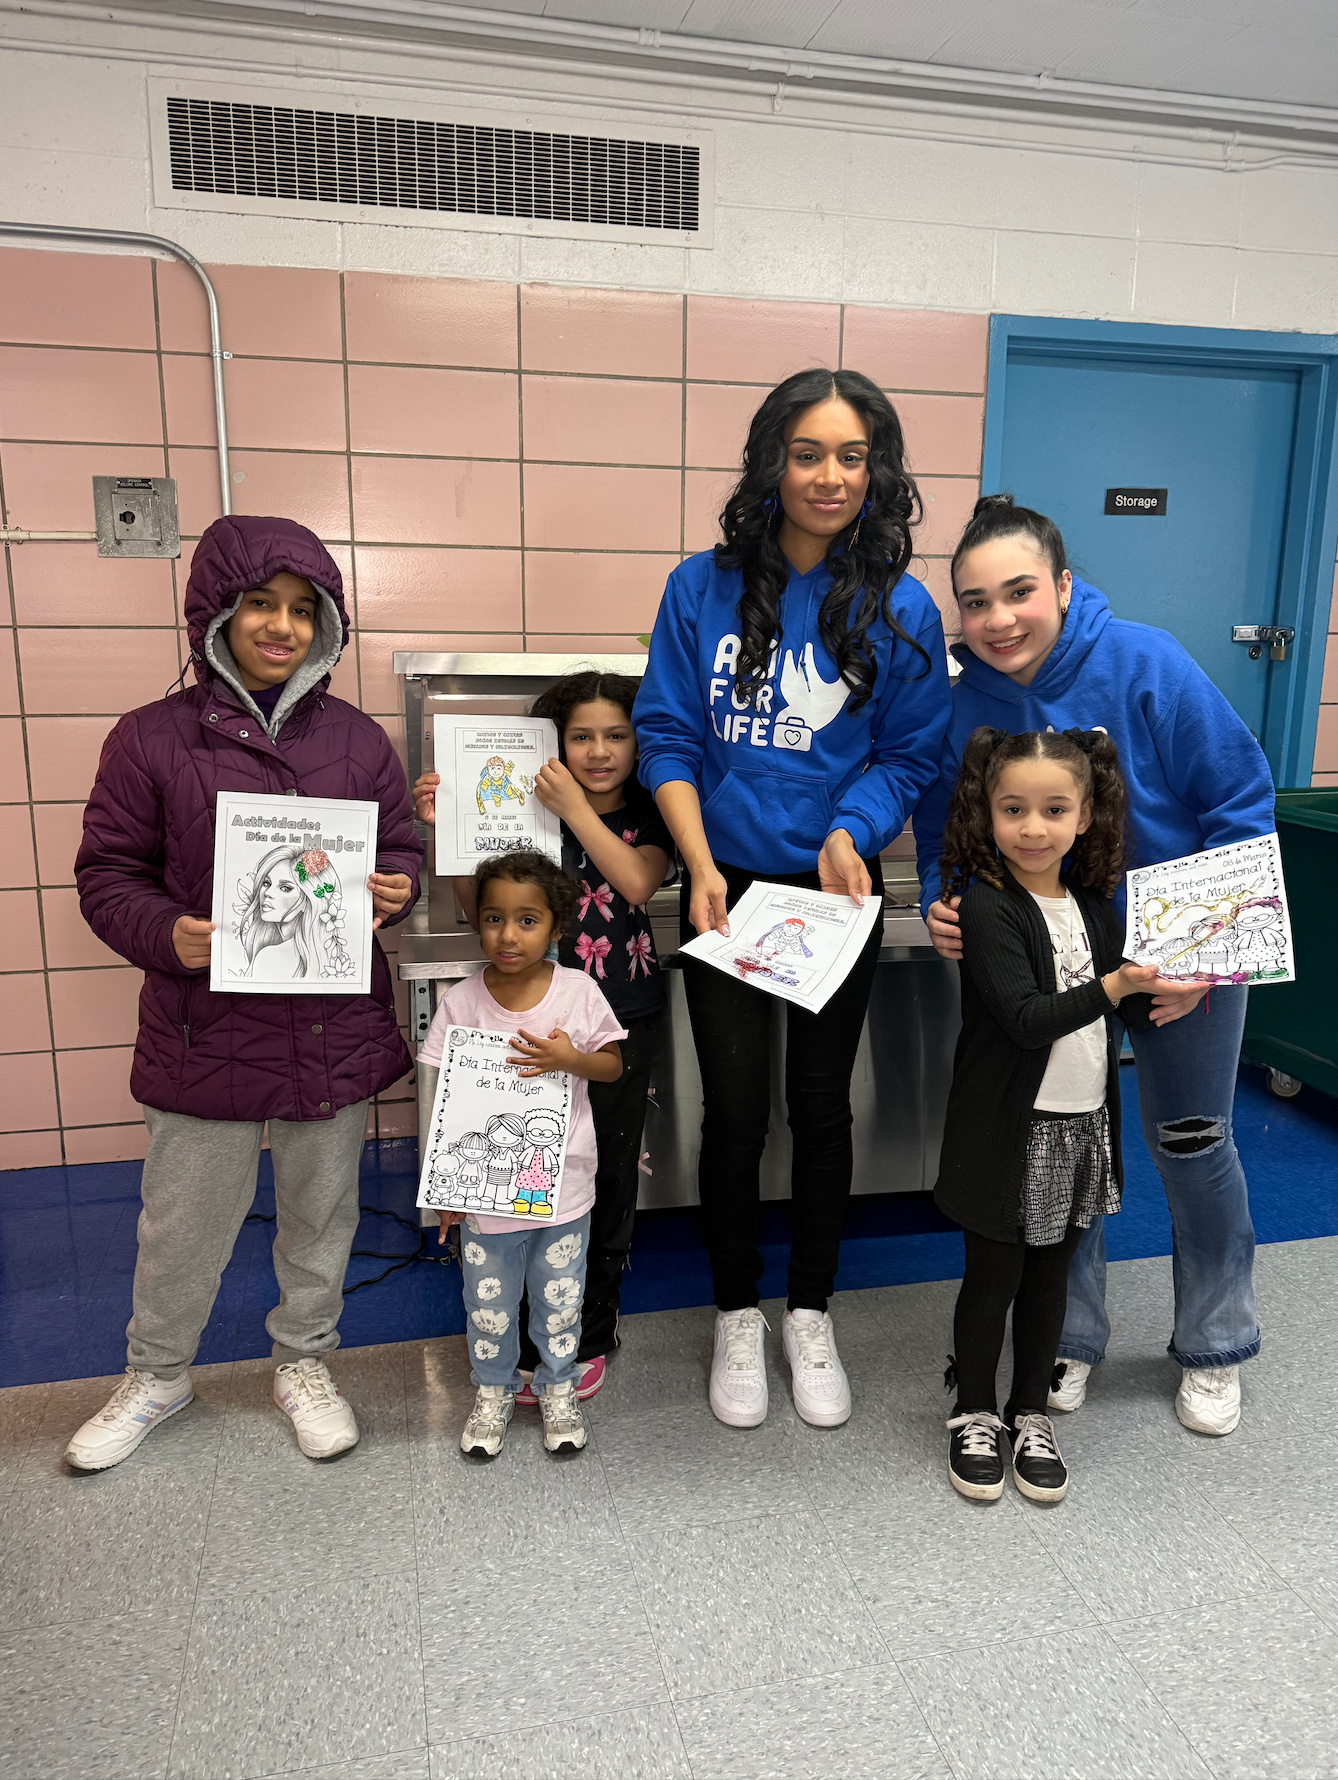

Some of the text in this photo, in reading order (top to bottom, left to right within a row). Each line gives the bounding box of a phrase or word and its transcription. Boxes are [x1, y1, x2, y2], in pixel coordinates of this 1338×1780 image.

[1115, 494, 1158, 509] Storage
[710, 710, 771, 747] LIFE
[231, 814, 321, 831] Actividades
[245, 831, 366, 853] Día de la Mujer
[1170, 861, 1262, 892] Internacional
[1169, 882, 1246, 906] de la Mujer
[476, 1075, 544, 1097] de la Mujer
